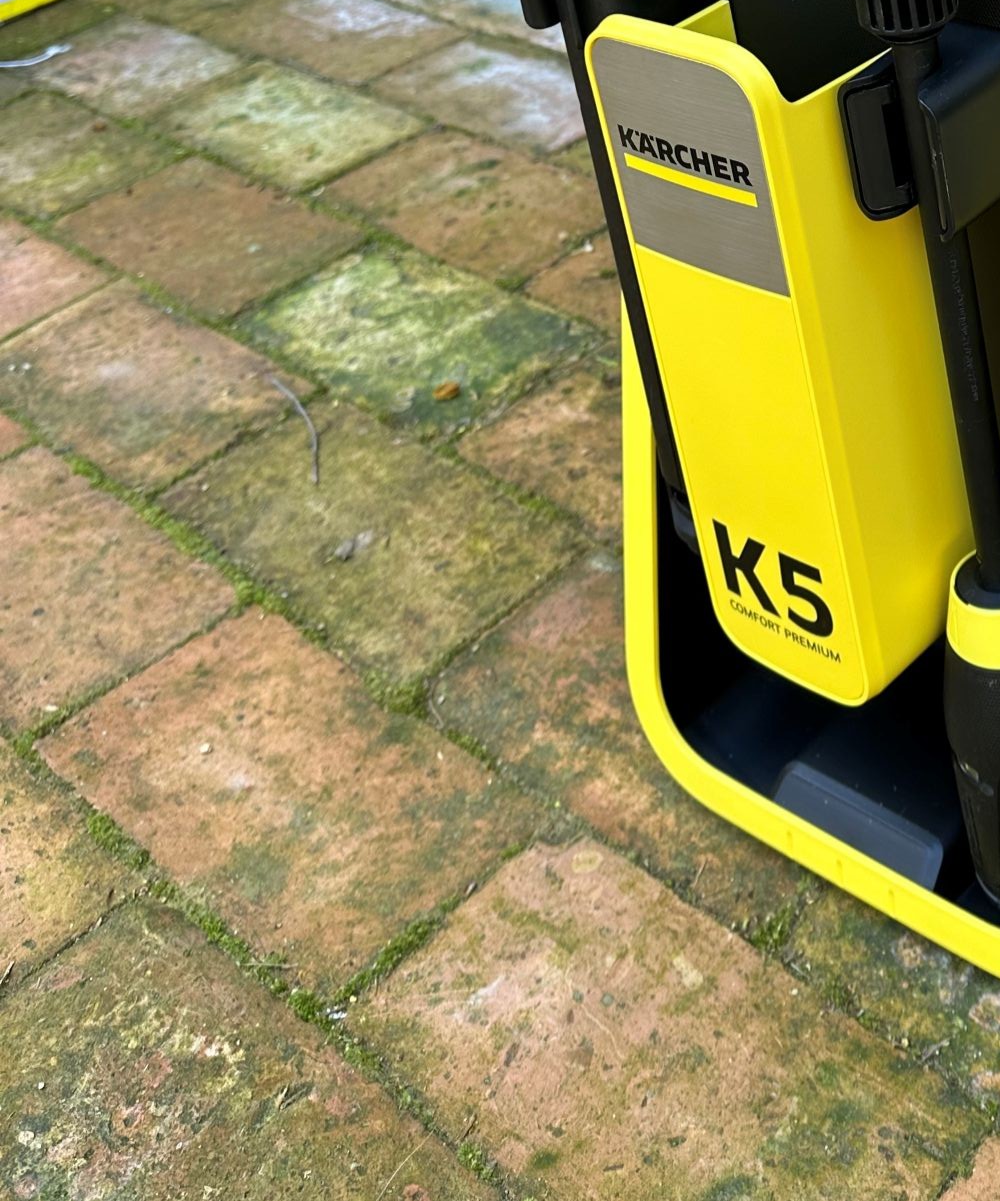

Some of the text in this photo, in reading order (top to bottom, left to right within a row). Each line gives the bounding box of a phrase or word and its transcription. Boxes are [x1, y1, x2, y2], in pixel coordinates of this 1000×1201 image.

[616, 123, 753, 187] KÄRCHER
[712, 517, 834, 638] K5
[730, 598, 842, 664] COMFORT PREMIUM
